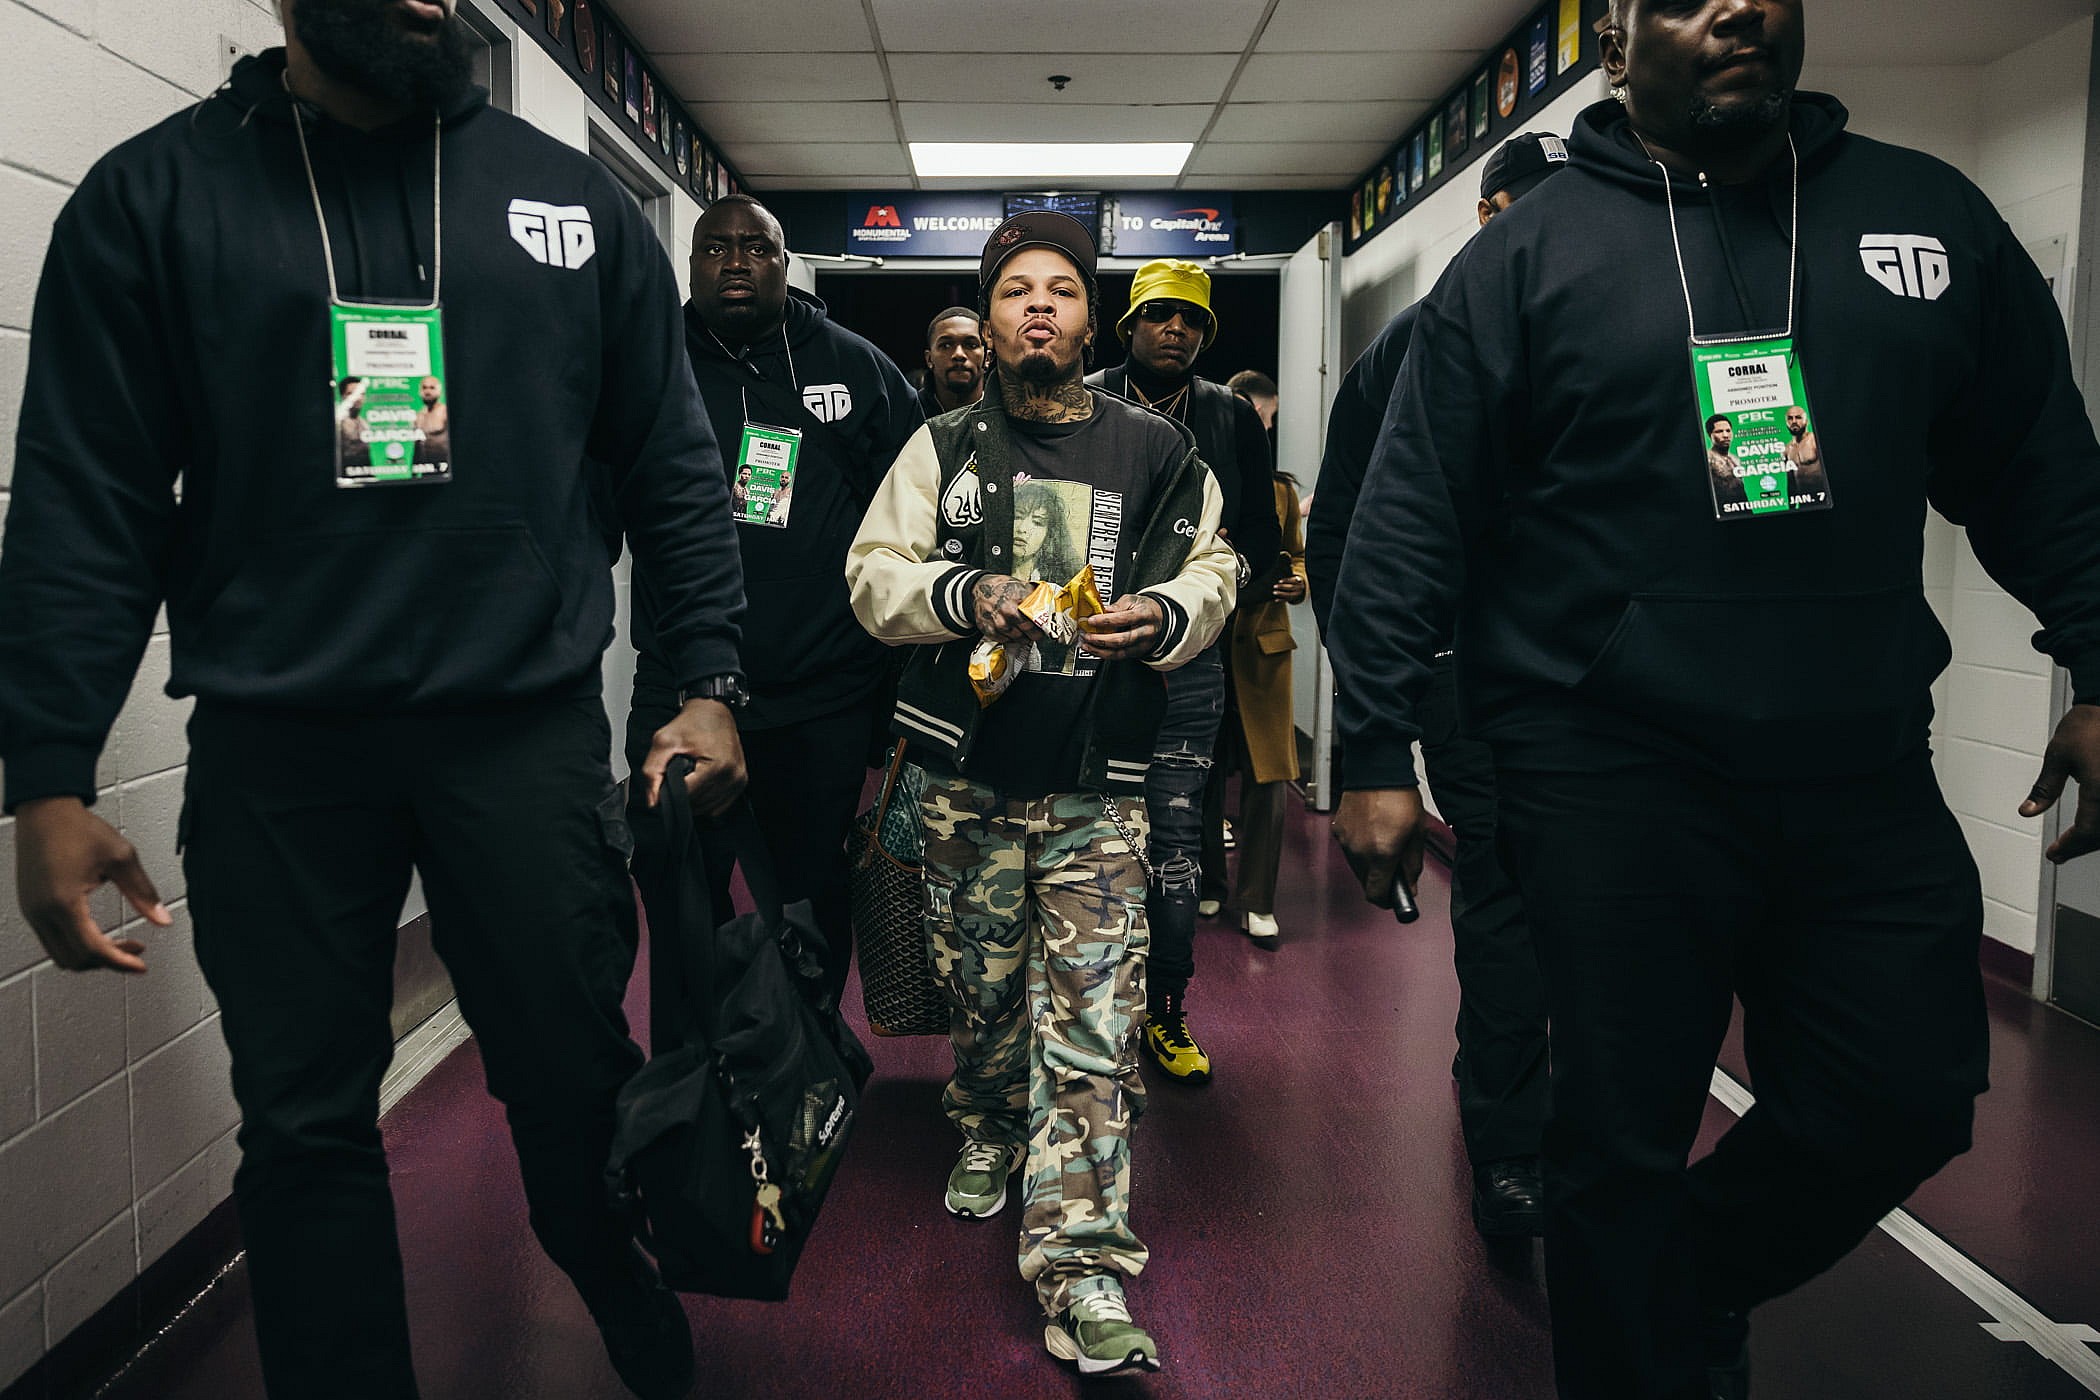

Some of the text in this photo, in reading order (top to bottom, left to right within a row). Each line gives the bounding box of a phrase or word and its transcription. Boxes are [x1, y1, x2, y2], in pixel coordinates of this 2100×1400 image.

[1121, 217, 1144, 231] TO
[853, 228, 912, 238] MONUMENTAL
[1194, 232, 1230, 241] Arena
[1728, 363, 1768, 377] CORRAL
[1729, 395, 1778, 407] PROMOTER
[1738, 411, 1775, 425] PBC
[359, 430, 427, 443] GARCIA
[1736, 441, 1786, 458] DAVIS
[1732, 460, 1799, 478] GARCIA
[749, 484, 776, 494] DAVIS
[744, 495, 777, 504] GARCIA
[1790, 493, 1815, 505] JAN.
[1817, 492, 1826, 502] 7
[1091, 490, 1121, 543] SIEMPRE
[1090, 547, 1115, 562] TE
